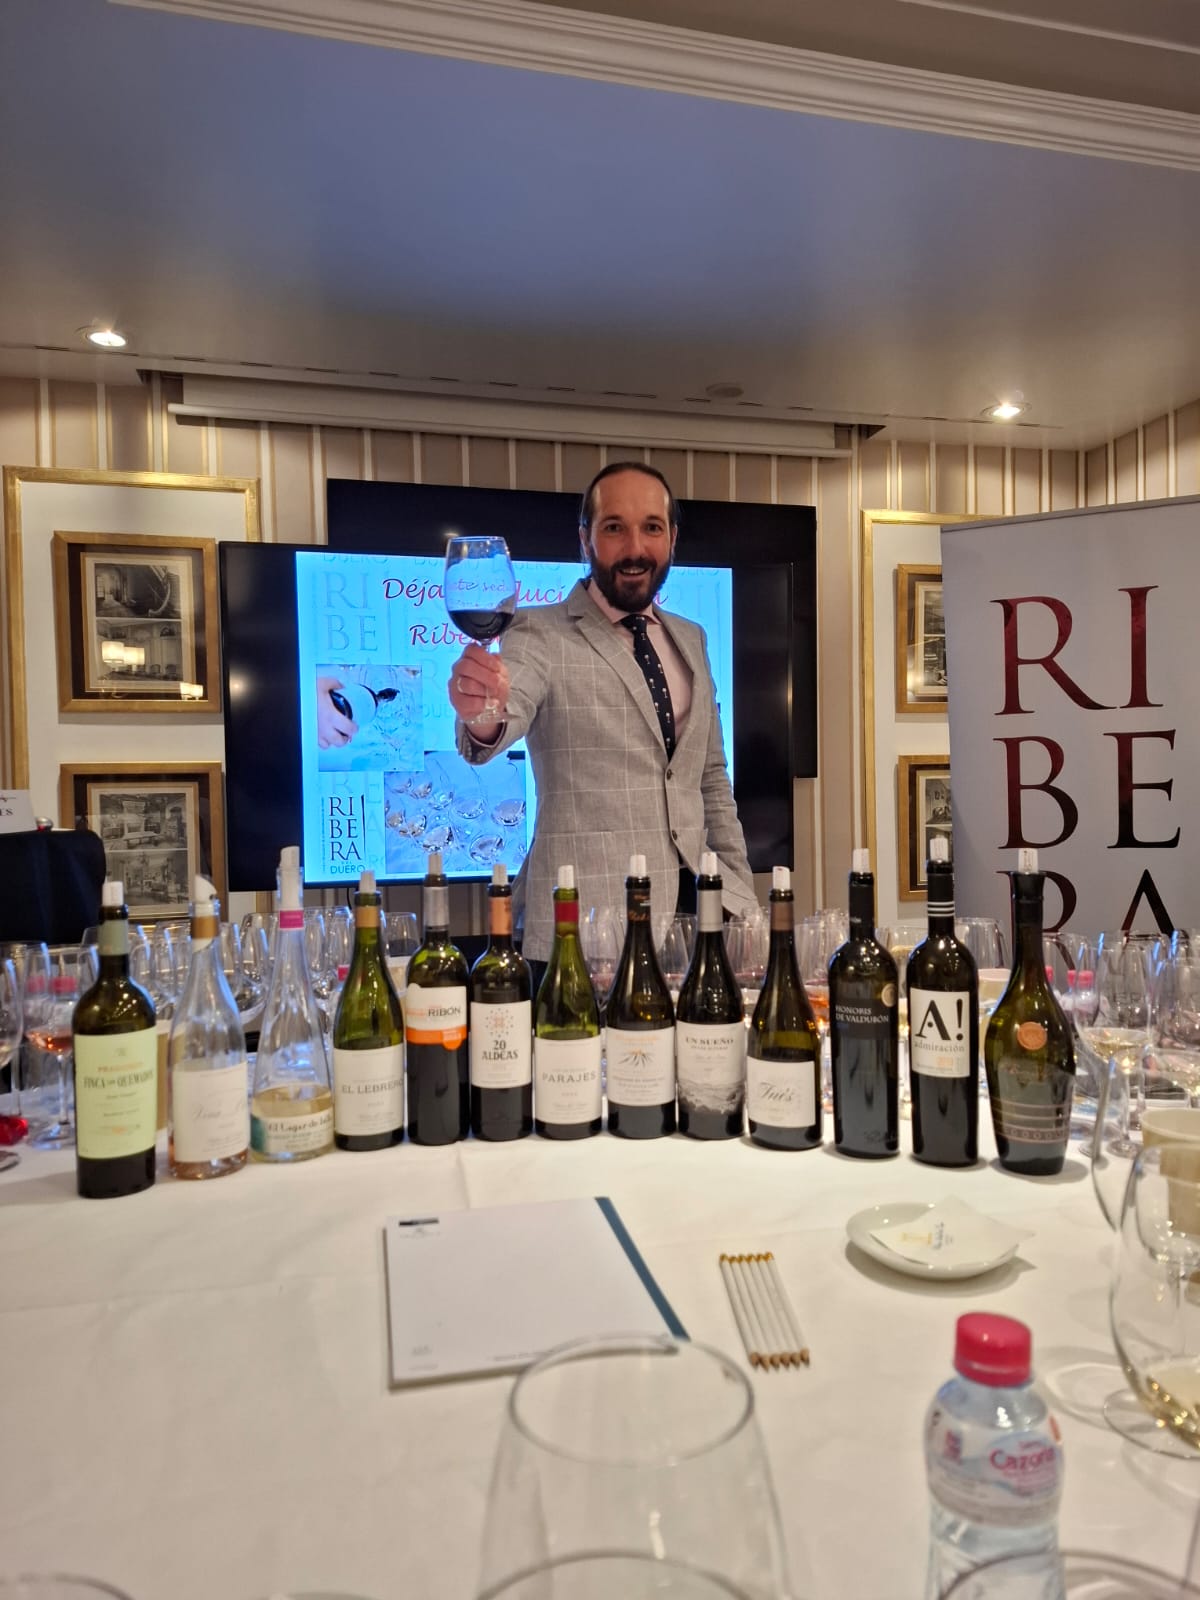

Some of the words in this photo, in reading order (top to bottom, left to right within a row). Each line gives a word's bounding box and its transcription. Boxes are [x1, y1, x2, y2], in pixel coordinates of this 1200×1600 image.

[989, 584, 1165, 716] RI
[992, 728, 1182, 851] BE
[330, 840, 362, 861] RA
[330, 864, 366, 875] DUERO
[542, 1071, 597, 1084] PARAJES
